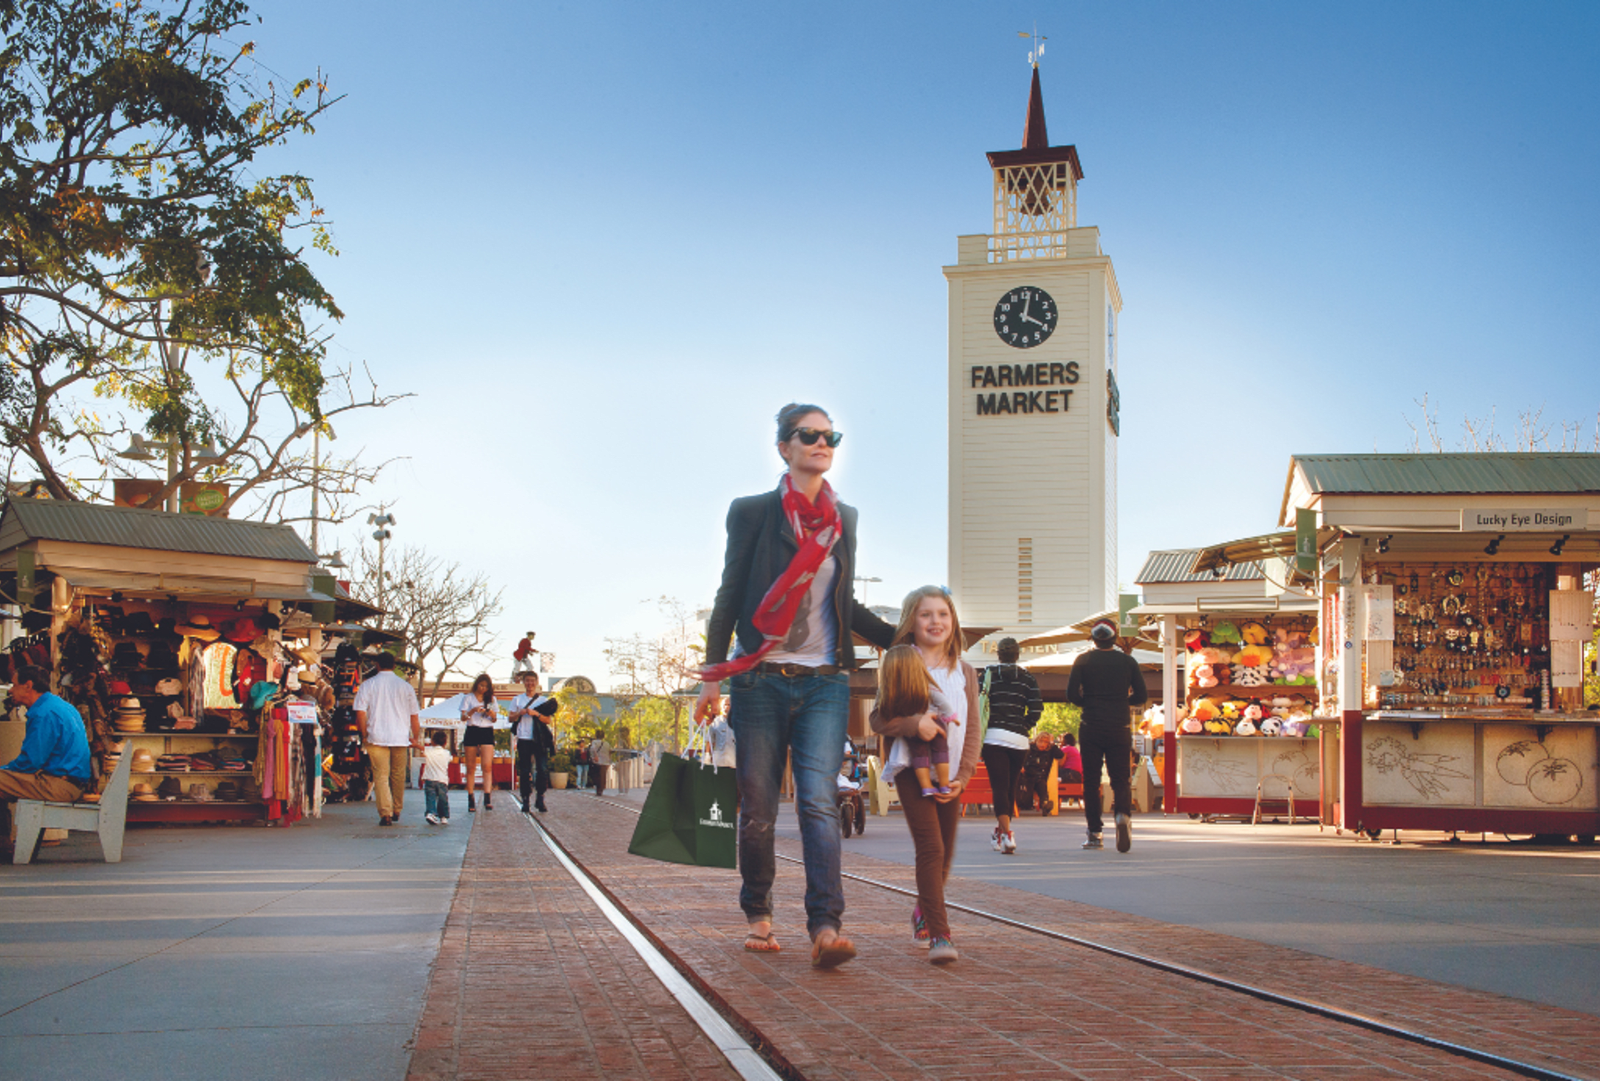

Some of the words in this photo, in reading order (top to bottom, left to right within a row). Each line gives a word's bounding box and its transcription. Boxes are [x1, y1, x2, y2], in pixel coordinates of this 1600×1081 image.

[1035, 293, 1039, 301] 1
[1042, 301, 1049, 310] 2
[1000, 314, 1006, 323] 9
[1045, 311, 1052, 320] 3
[1003, 325, 1009, 334] 8
[1042, 323, 1049, 332] 4
[1011, 332, 1018, 342] 7
[1021, 335, 1029, 344] 6
[1034, 331, 1040, 340] 5
[972, 361, 1080, 388] FARMERS
[976, 389, 1074, 416] MARKET
[1476, 514, 1508, 528] Lucky
[1511, 513, 1531, 528] Eye
[1534, 512, 1573, 527] Design
